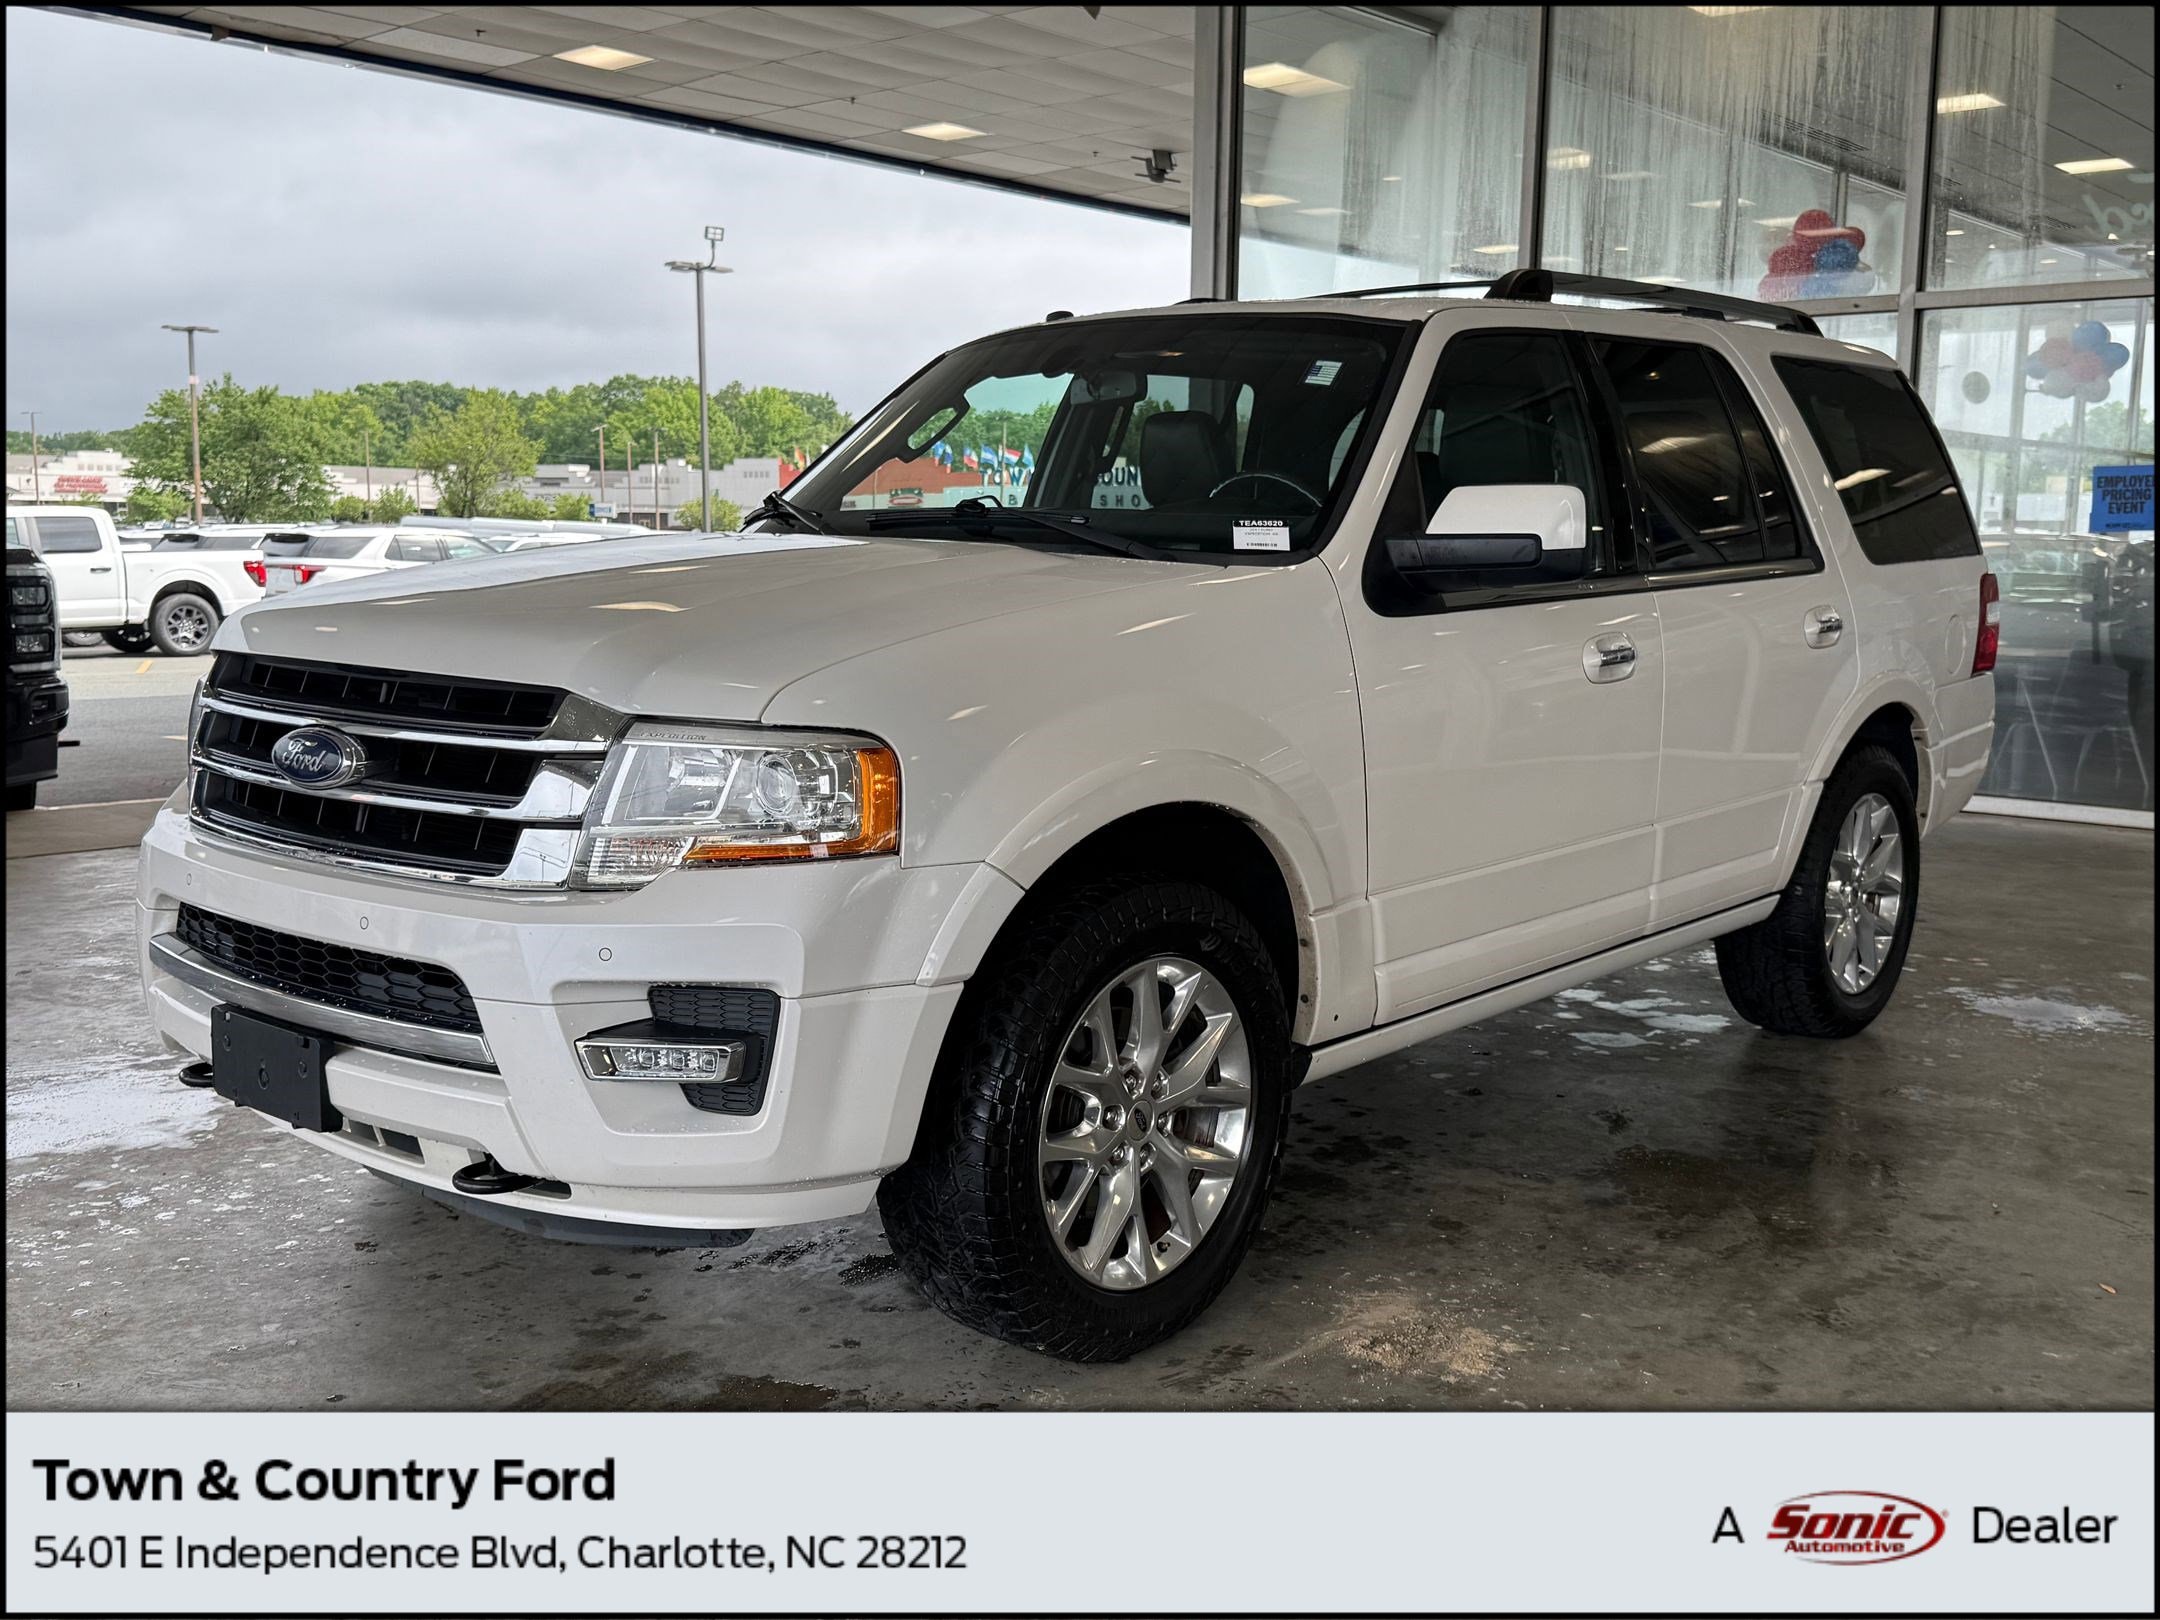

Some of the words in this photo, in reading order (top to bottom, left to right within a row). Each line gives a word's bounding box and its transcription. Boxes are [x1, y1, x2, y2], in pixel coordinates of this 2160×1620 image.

[980, 469, 1033, 486] TOW
[2097, 475, 2154, 488] EMPLOYE
[2102, 488, 2151, 501] PRICING
[2108, 502, 2145, 514] EVENT
[282, 738, 327, 773] Ford
